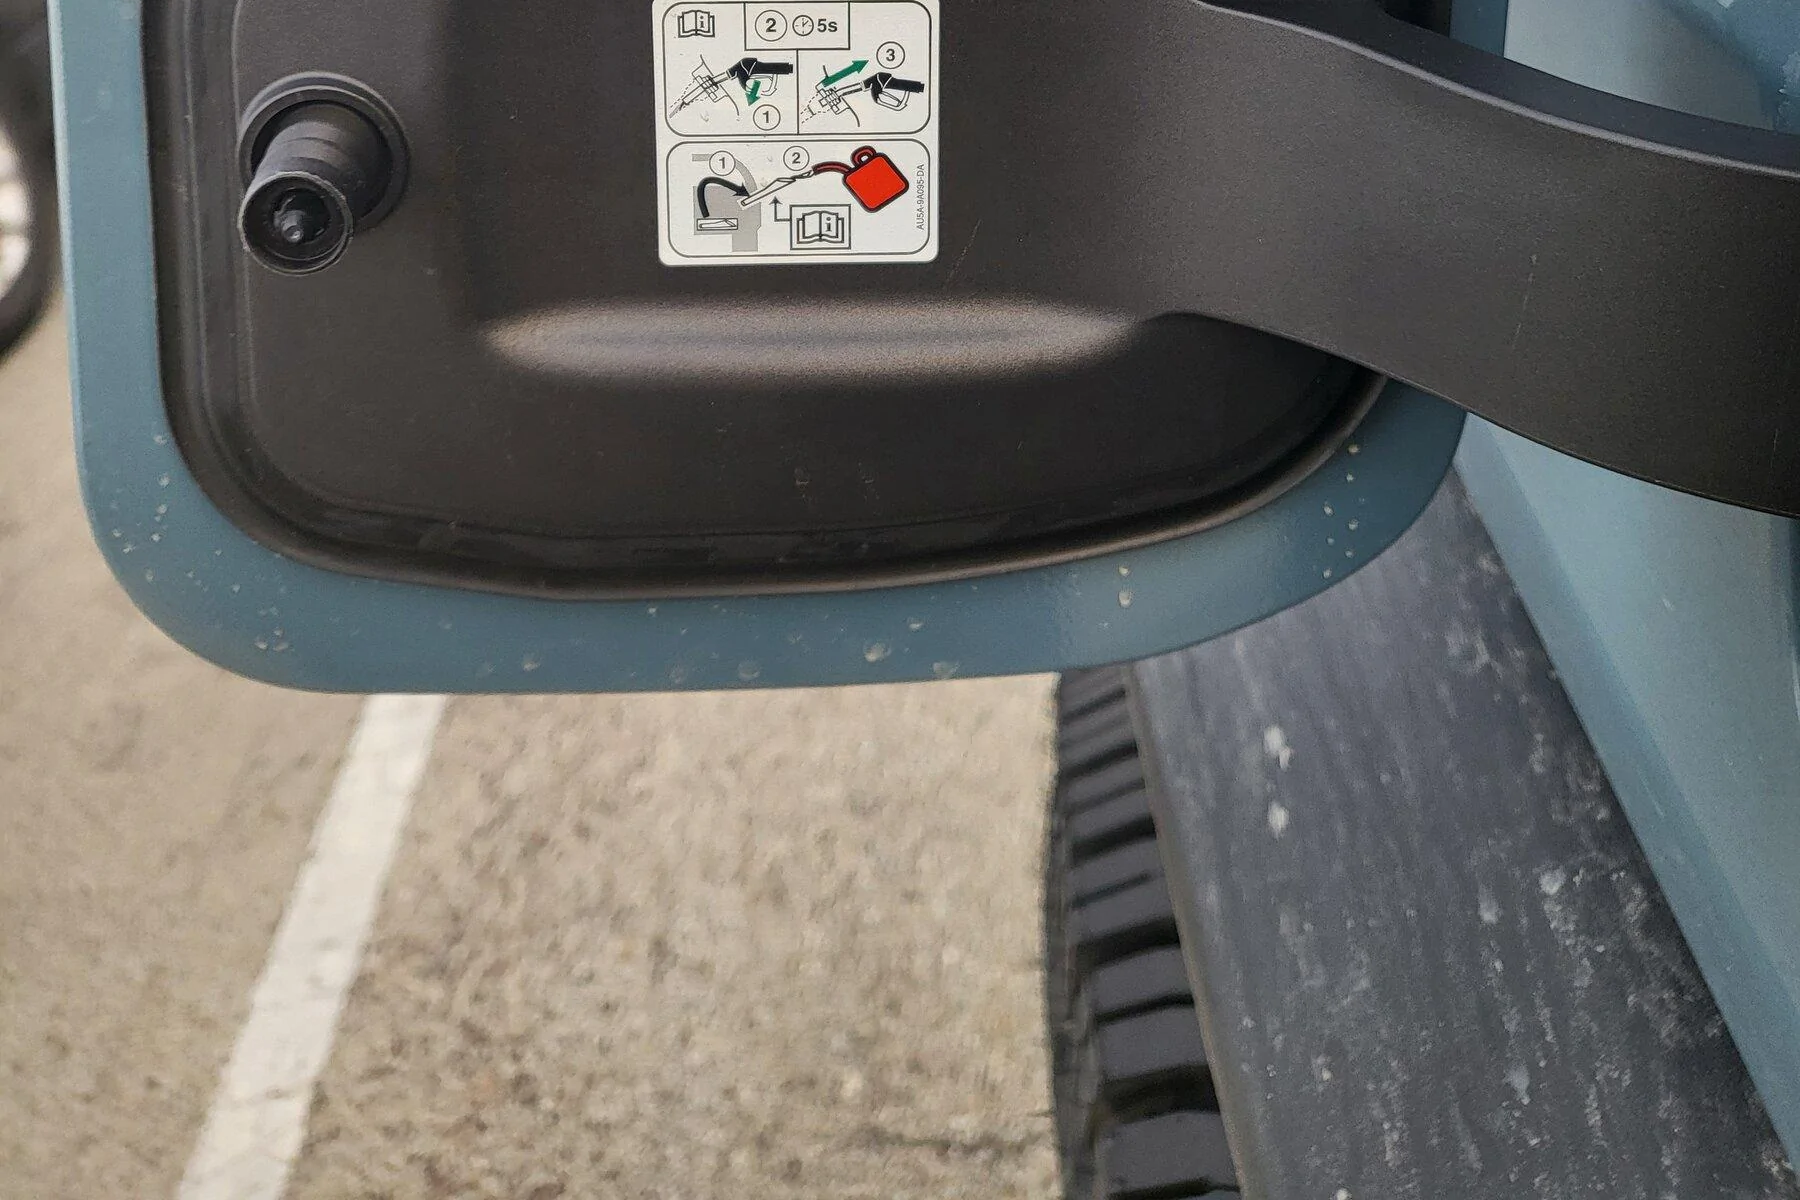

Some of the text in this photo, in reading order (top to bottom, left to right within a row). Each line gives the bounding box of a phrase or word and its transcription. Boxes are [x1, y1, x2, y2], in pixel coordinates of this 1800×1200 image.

[765, 17, 838, 33] 2 5s
[885, 48, 896, 62] 3
[762, 110, 771, 124] 1
[719, 155, 726, 169] 1
[791, 152, 801, 164] 2
